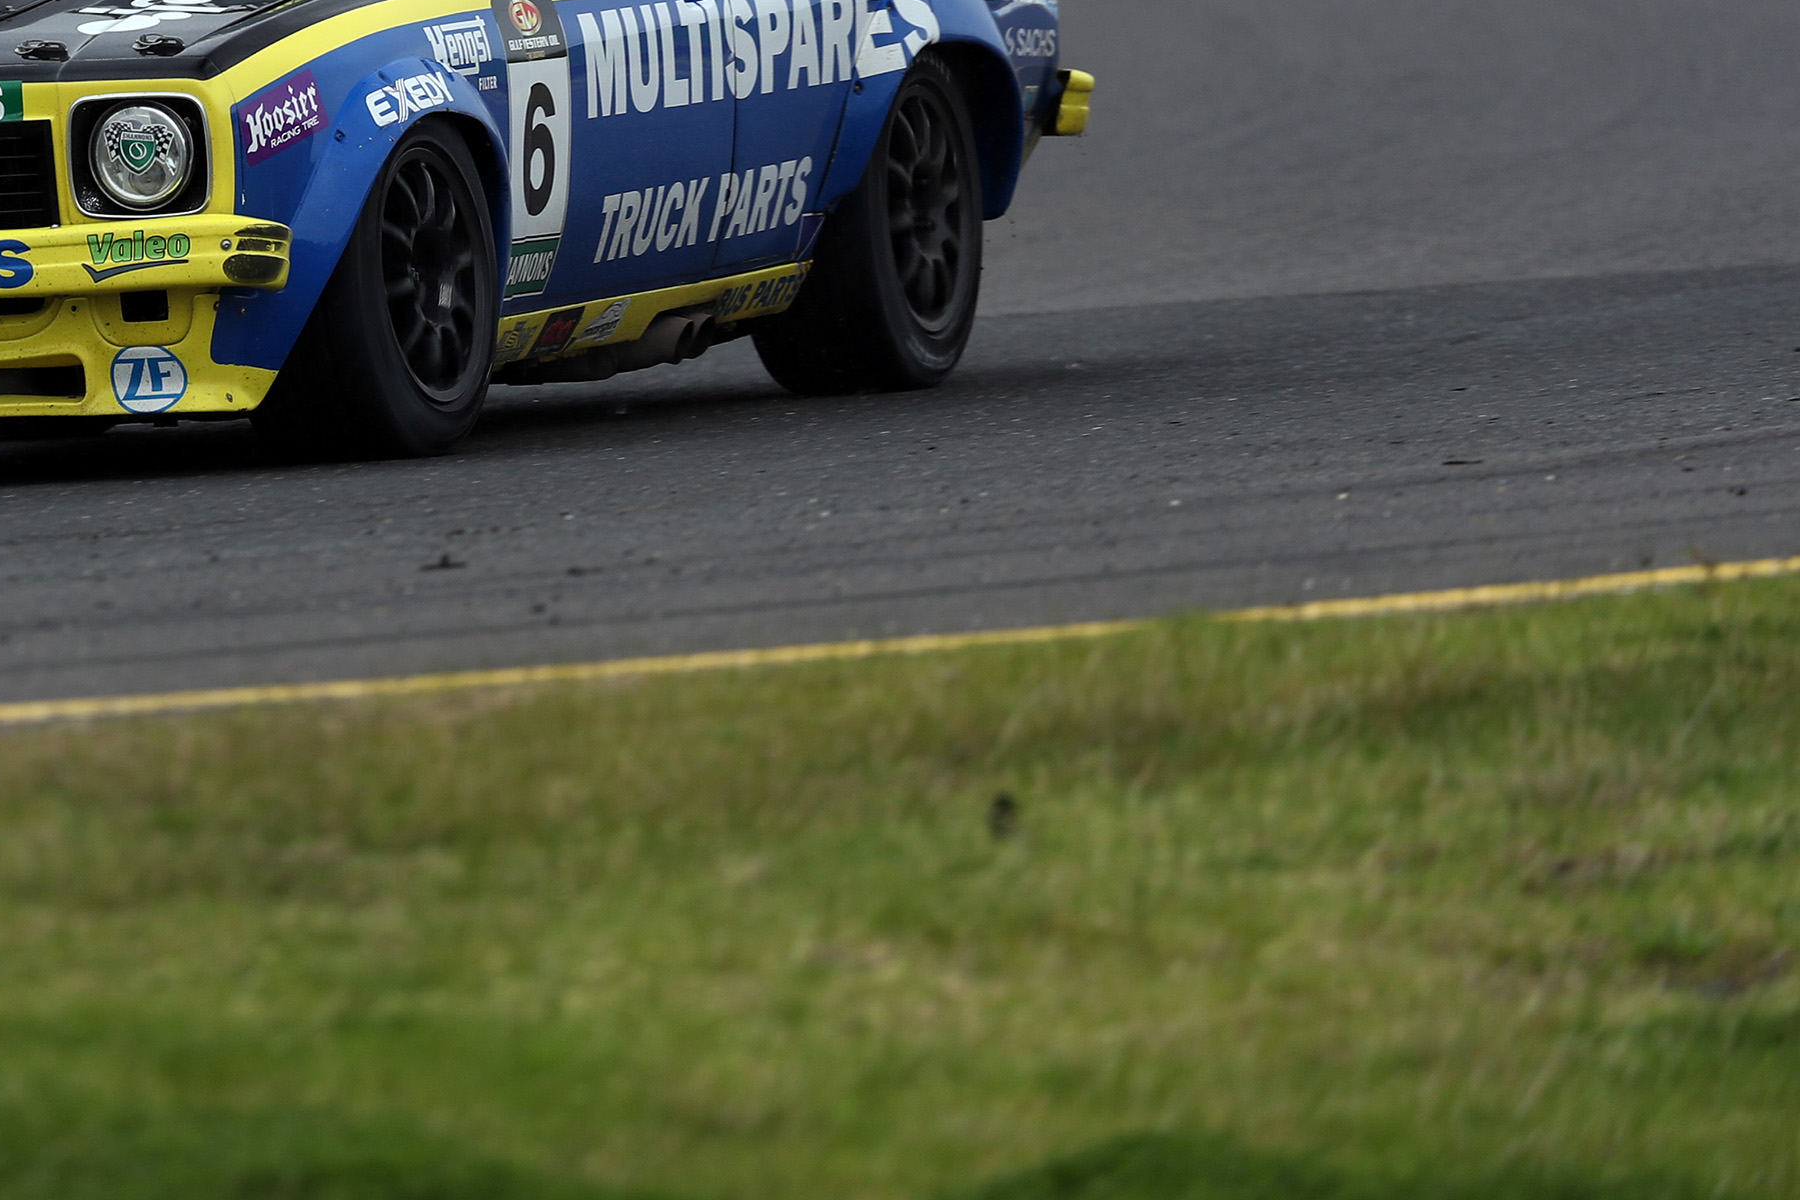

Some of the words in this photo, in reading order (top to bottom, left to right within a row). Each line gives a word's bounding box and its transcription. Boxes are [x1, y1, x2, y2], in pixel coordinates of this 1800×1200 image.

[422, 15, 493, 75] Hengst
[1016, 28, 1057, 57] SACHS
[365, 71, 454, 128] EXEDY
[478, 75, 498, 92] FILTER
[245, 82, 319, 155] Hoosier
[270, 127, 301, 150] RACING
[302, 114, 320, 134] TIRE
[523, 82, 556, 216] 6
[593, 176, 710, 264] TRUCK
[706, 155, 813, 243] PARTS
[87, 229, 191, 264] Valeo
[112, 355, 187, 402] ZF
